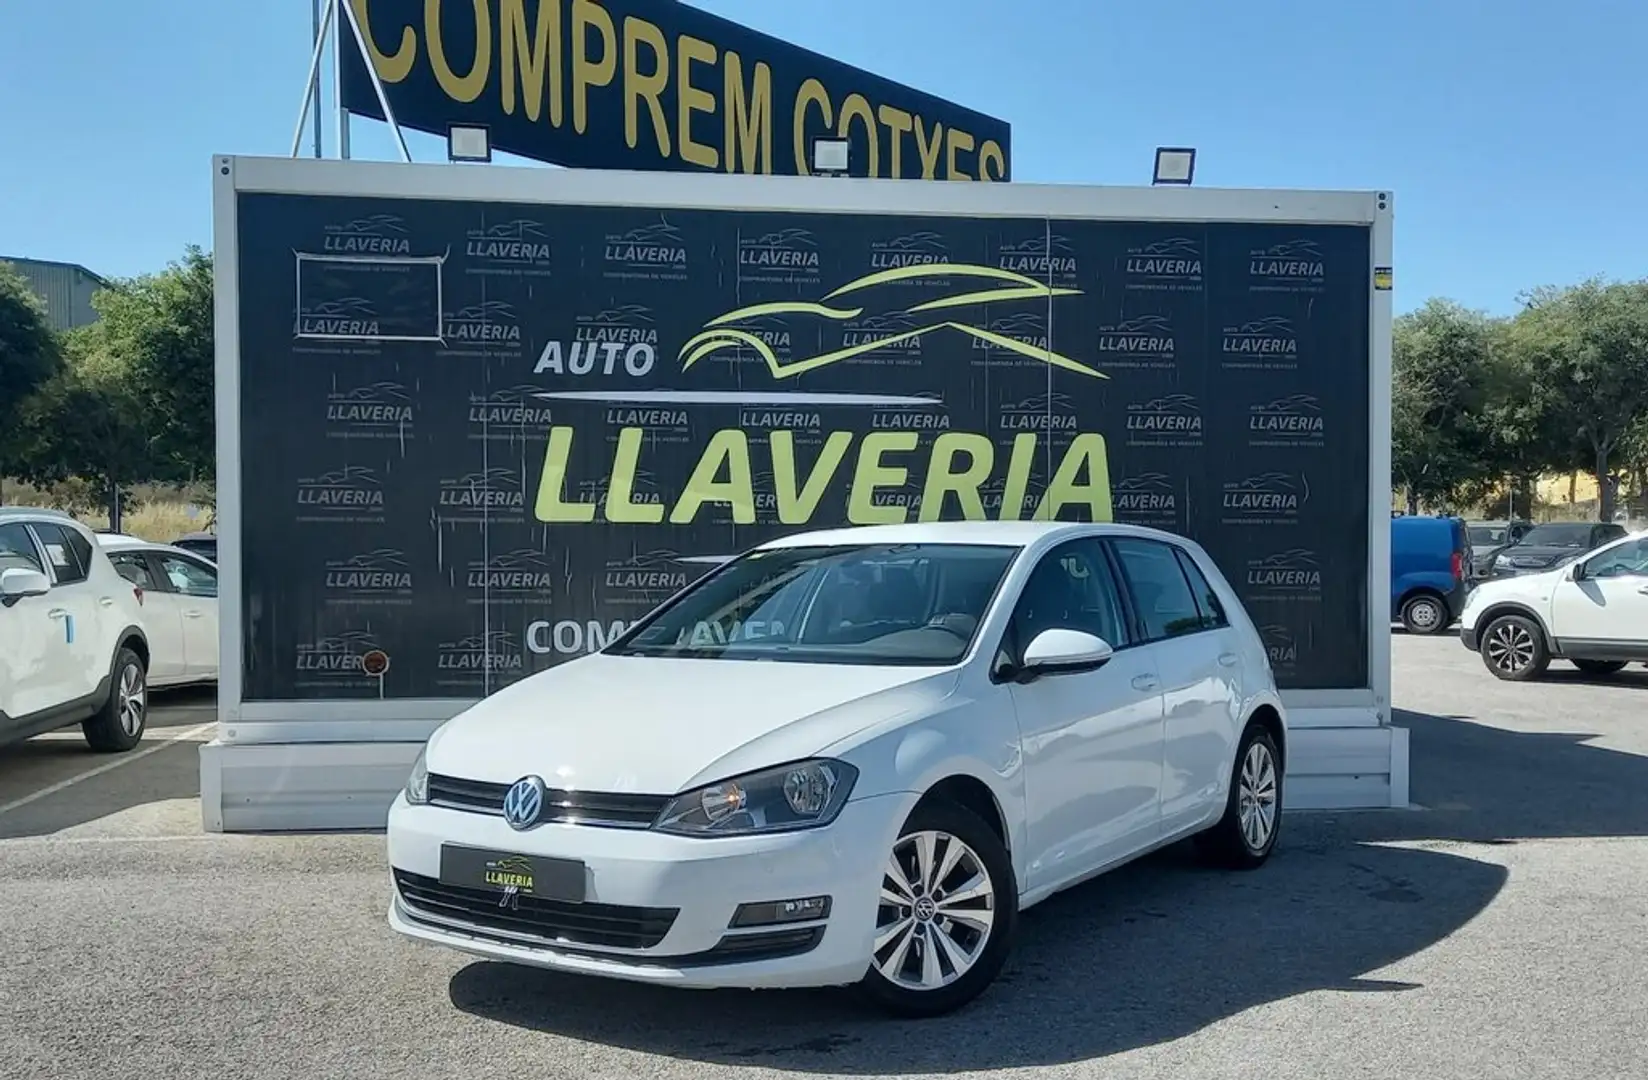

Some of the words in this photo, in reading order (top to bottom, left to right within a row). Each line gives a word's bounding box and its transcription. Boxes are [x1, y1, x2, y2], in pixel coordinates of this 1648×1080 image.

[324, 236, 410, 253] LLAVERIA
[467, 241, 550, 259] LLAVERIA
[604, 245, 686, 262] LLAVERIA
[740, 249, 819, 266] LLAVERIA
[999, 255, 1076, 272] LLAVERIA
[1126, 259, 1202, 274] LLAVERIA
[1250, 260, 1324, 276] LLAVERIA
[576, 327, 658, 343] LLAVERIA
[1099, 337, 1174, 352] LLAVERIA
[1223, 338, 1296, 352] LLAVERIA
[533, 341, 654, 375] AUTO
[327, 405, 413, 421] LLAVERIA
[469, 408, 551, 423] LLAVERIA
[607, 410, 688, 425] LLAVERIA
[741, 412, 821, 426] LLAVERIA
[872, 414, 949, 429] LLAVERIA
[1000, 415, 1077, 429] LLAVERIA
[1126, 415, 1202, 430] LLAVERIA
[1250, 416, 1323, 430] LLAVERIA
[534, 426, 1113, 525] LLAVERIA
[297, 489, 383, 504] LLAVERIA
[439, 490, 524, 506] LLAVERIA
[1223, 494, 1297, 508] LLAVERIA
[326, 572, 412, 587] LLAVERIA
[468, 572, 551, 587] LLAVERIA
[606, 573, 687, 587] LLAVERIA
[1248, 571, 1321, 584] LLAVERIA
[438, 654, 522, 669] LLAVERIA
[485, 871, 533, 888] LLAVERIA
